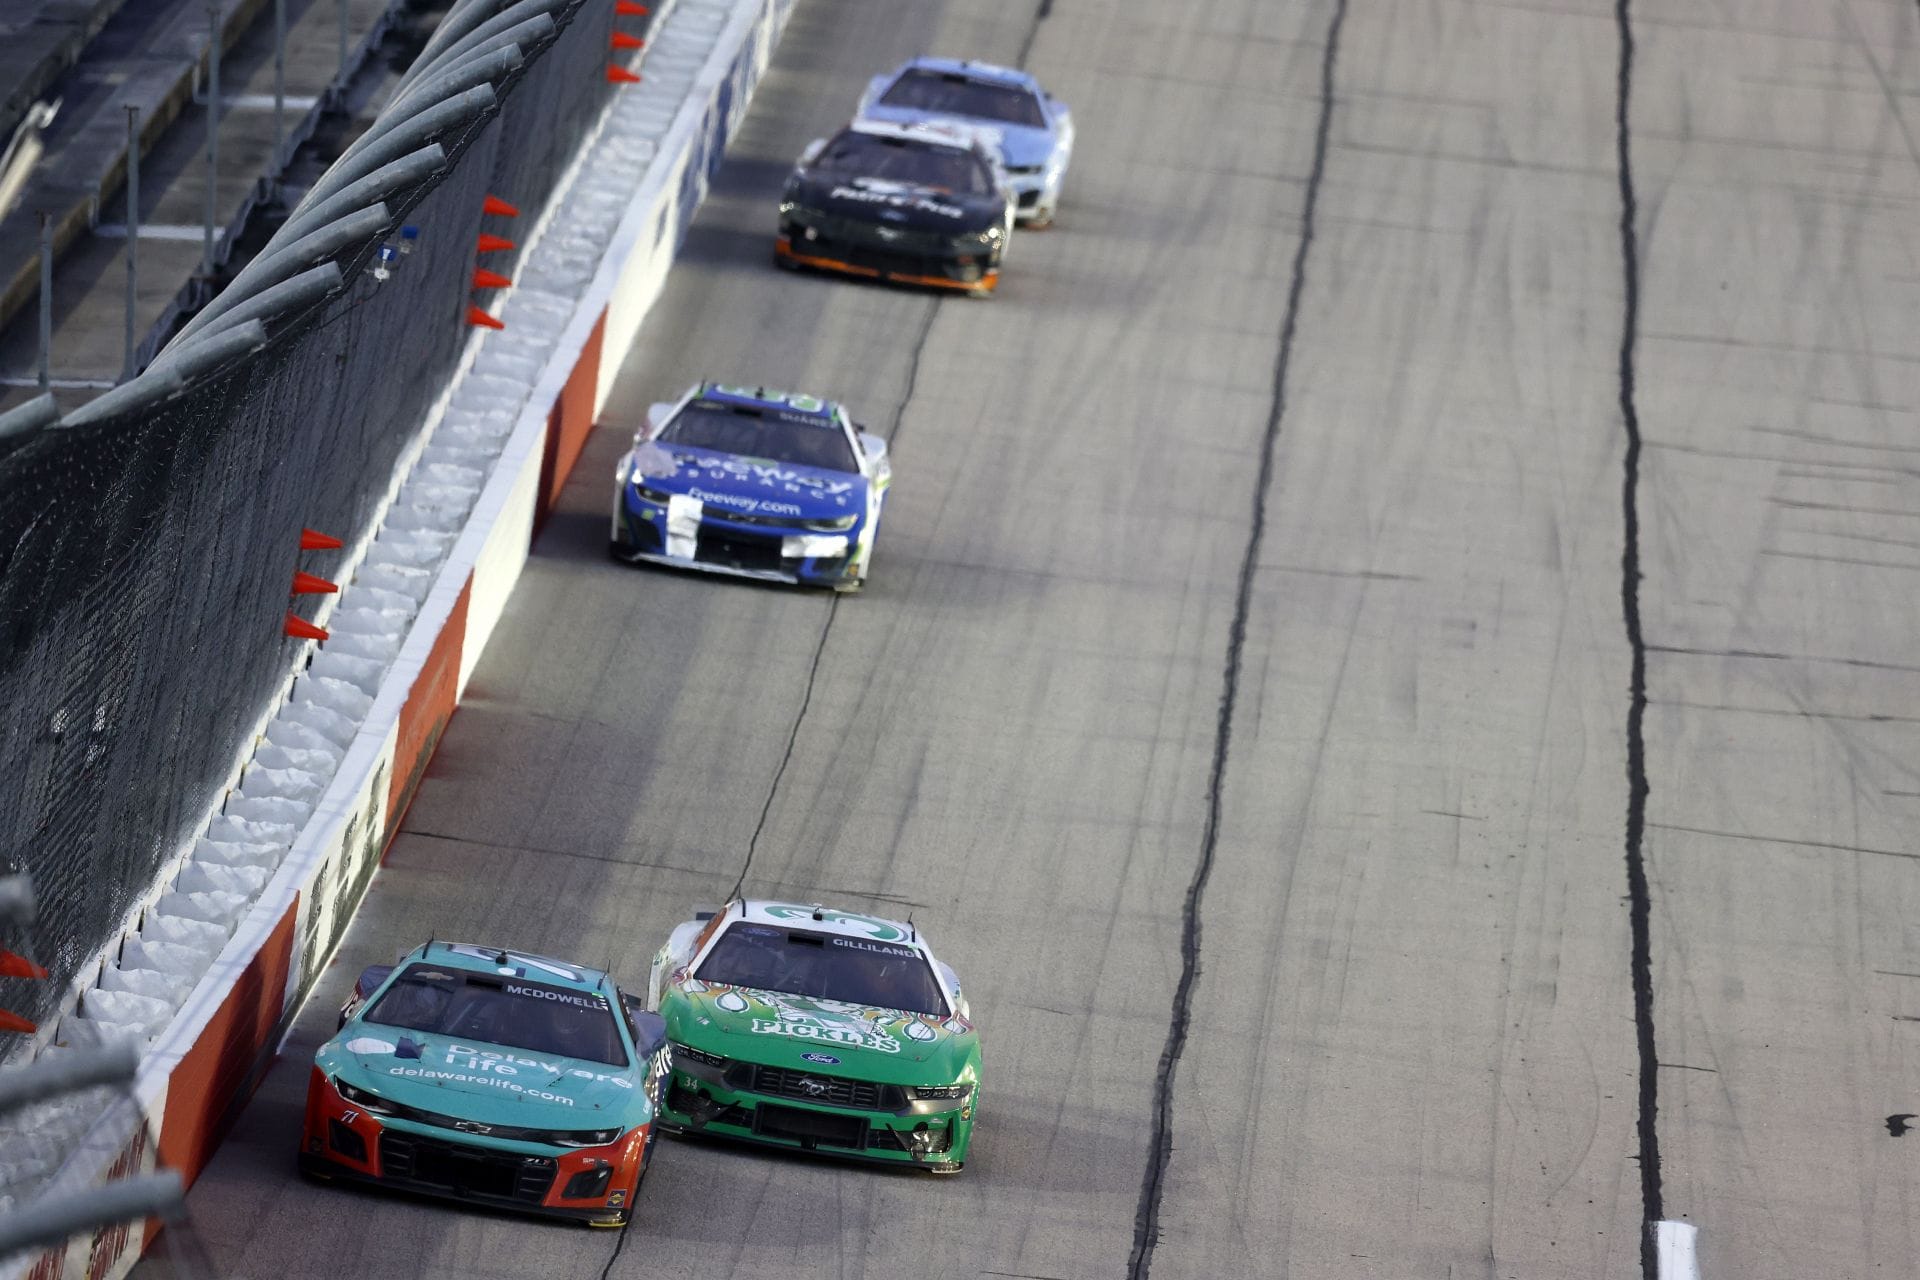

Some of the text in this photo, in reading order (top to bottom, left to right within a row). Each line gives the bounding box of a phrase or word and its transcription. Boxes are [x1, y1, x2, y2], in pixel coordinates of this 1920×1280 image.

[833, 938, 915, 959] GILLILAND
[507, 984, 604, 1010] MCDOWELL
[752, 1019, 900, 1053] PICKLES
[803, 1053, 838, 1065] Ford
[389, 1066, 574, 1107] delawarelife.com
[684, 1076, 698, 1090] 34
[341, 1109, 359, 1124] 71
